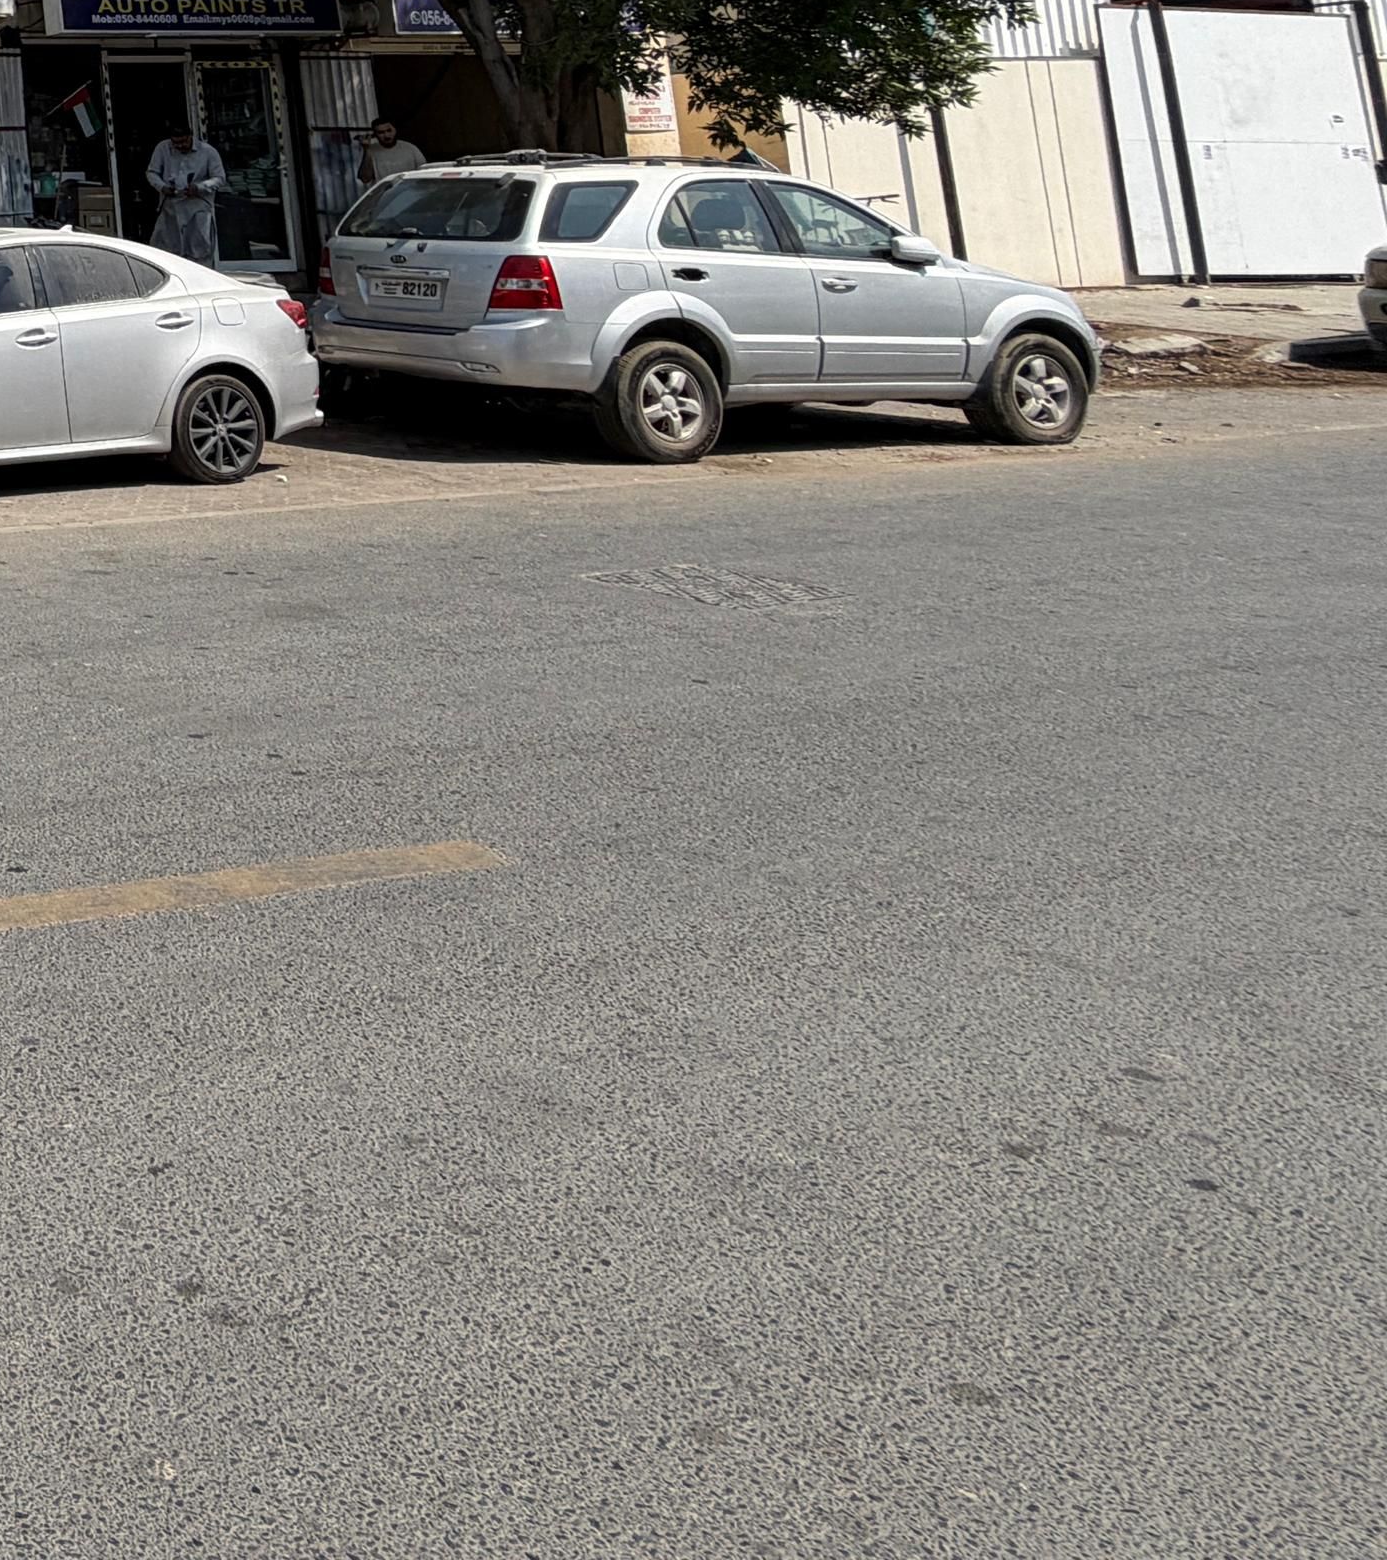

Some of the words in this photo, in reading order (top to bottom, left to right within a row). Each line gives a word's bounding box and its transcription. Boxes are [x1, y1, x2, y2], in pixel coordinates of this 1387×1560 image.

[177, 0, 267, 14] PAINTS
[272, 0, 307, 14] TR
[402, 281, 438, 298] 82120
